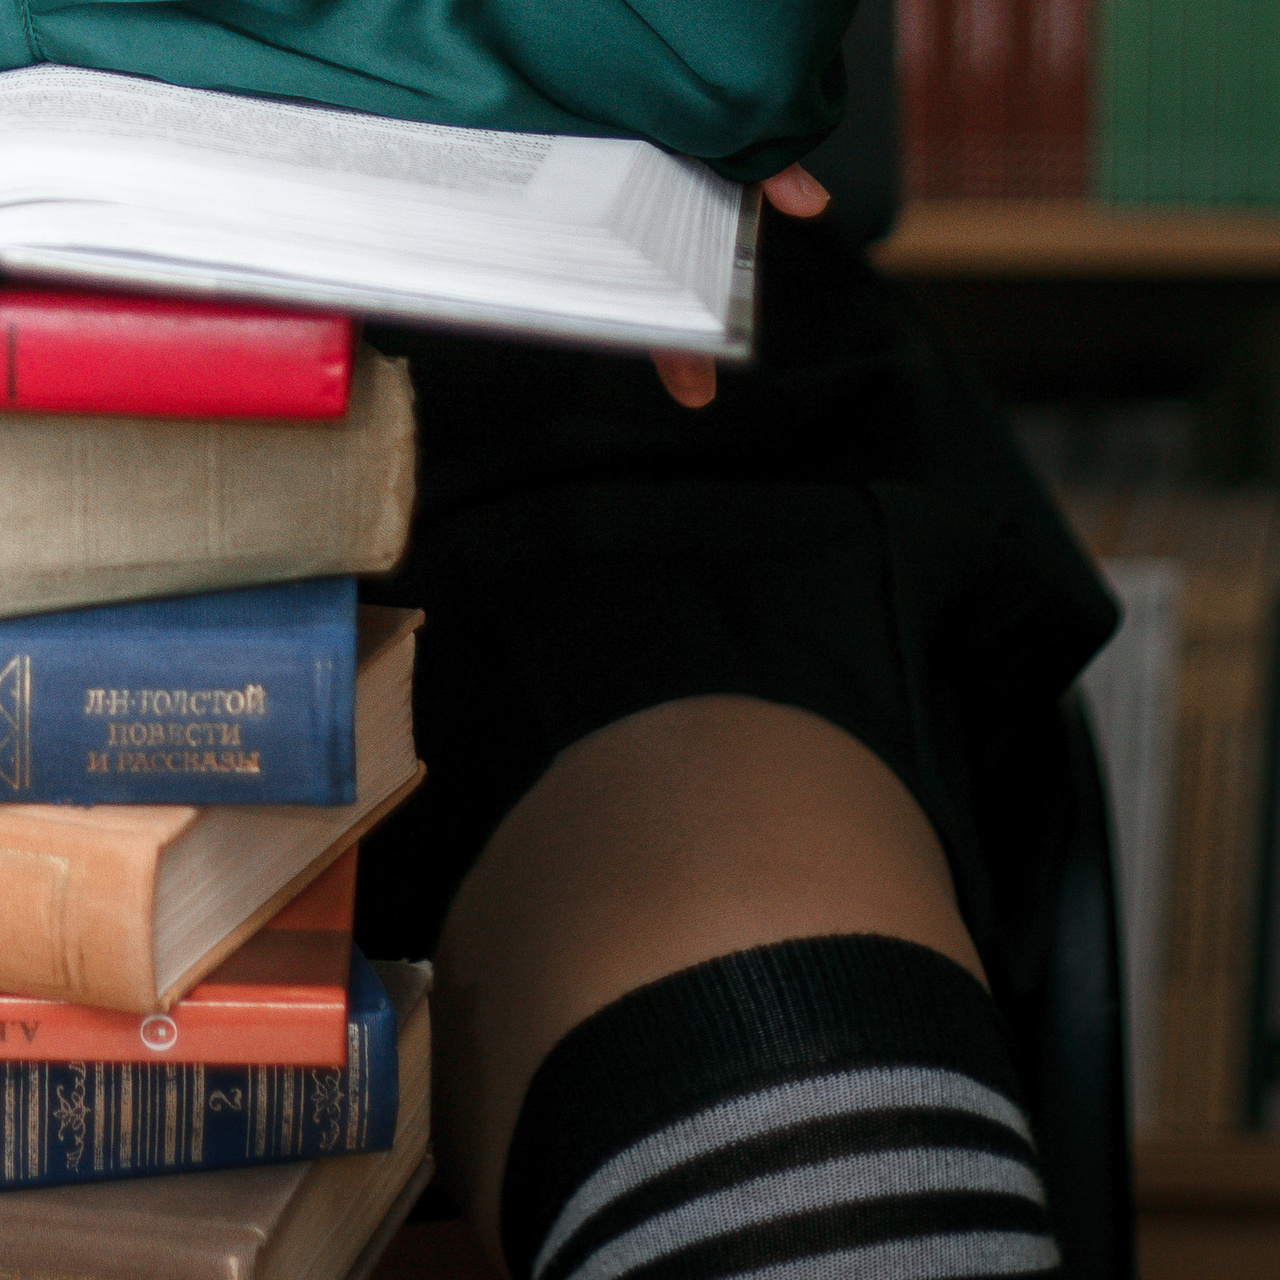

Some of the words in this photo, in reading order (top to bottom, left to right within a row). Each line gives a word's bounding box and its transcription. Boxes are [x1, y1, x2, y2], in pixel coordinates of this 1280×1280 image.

[108, 722, 242, 747] ПОВЕСТИ
[87, 751, 109, 774] И
[117, 750, 262, 775] РАССКАЗЫ
